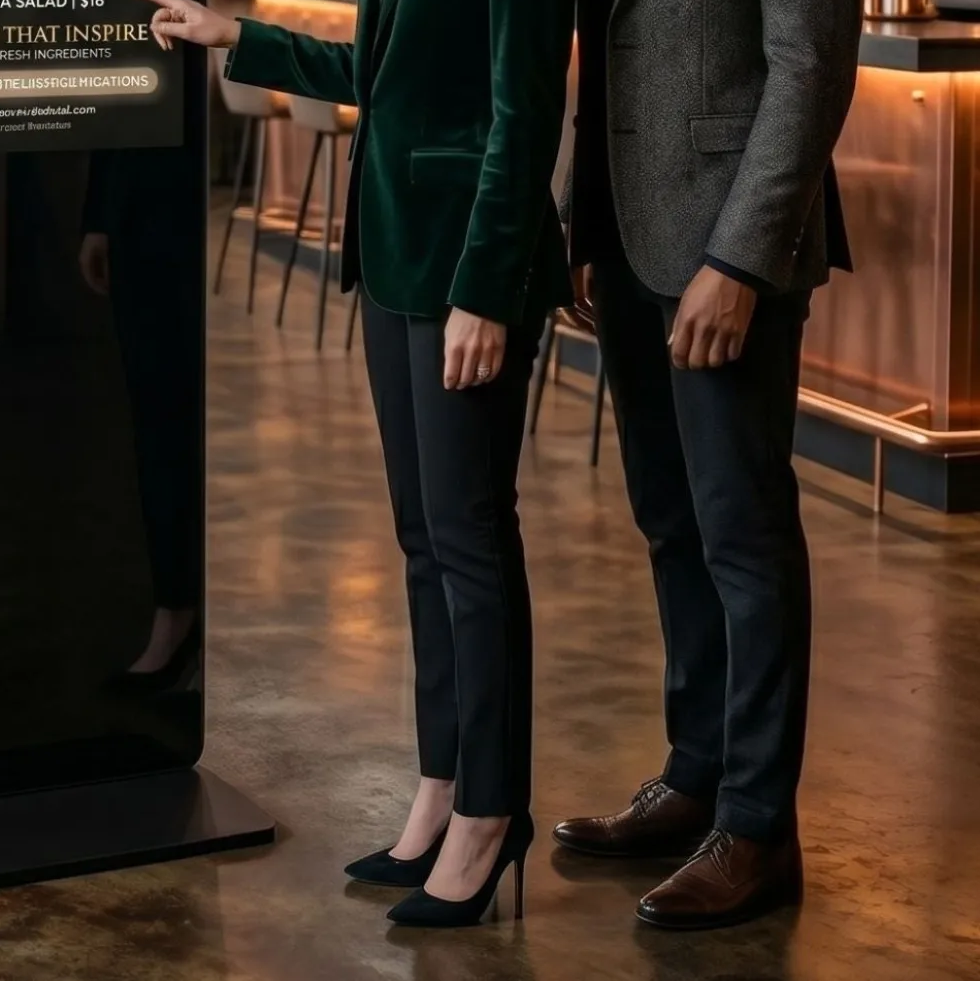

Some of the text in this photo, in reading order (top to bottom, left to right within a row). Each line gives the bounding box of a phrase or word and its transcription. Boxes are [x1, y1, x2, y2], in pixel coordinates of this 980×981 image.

[2, 25, 62, 44] THAT
[66, 23, 149, 42] INSPIRE
[34, 47, 112, 60] INGREDIENTS
